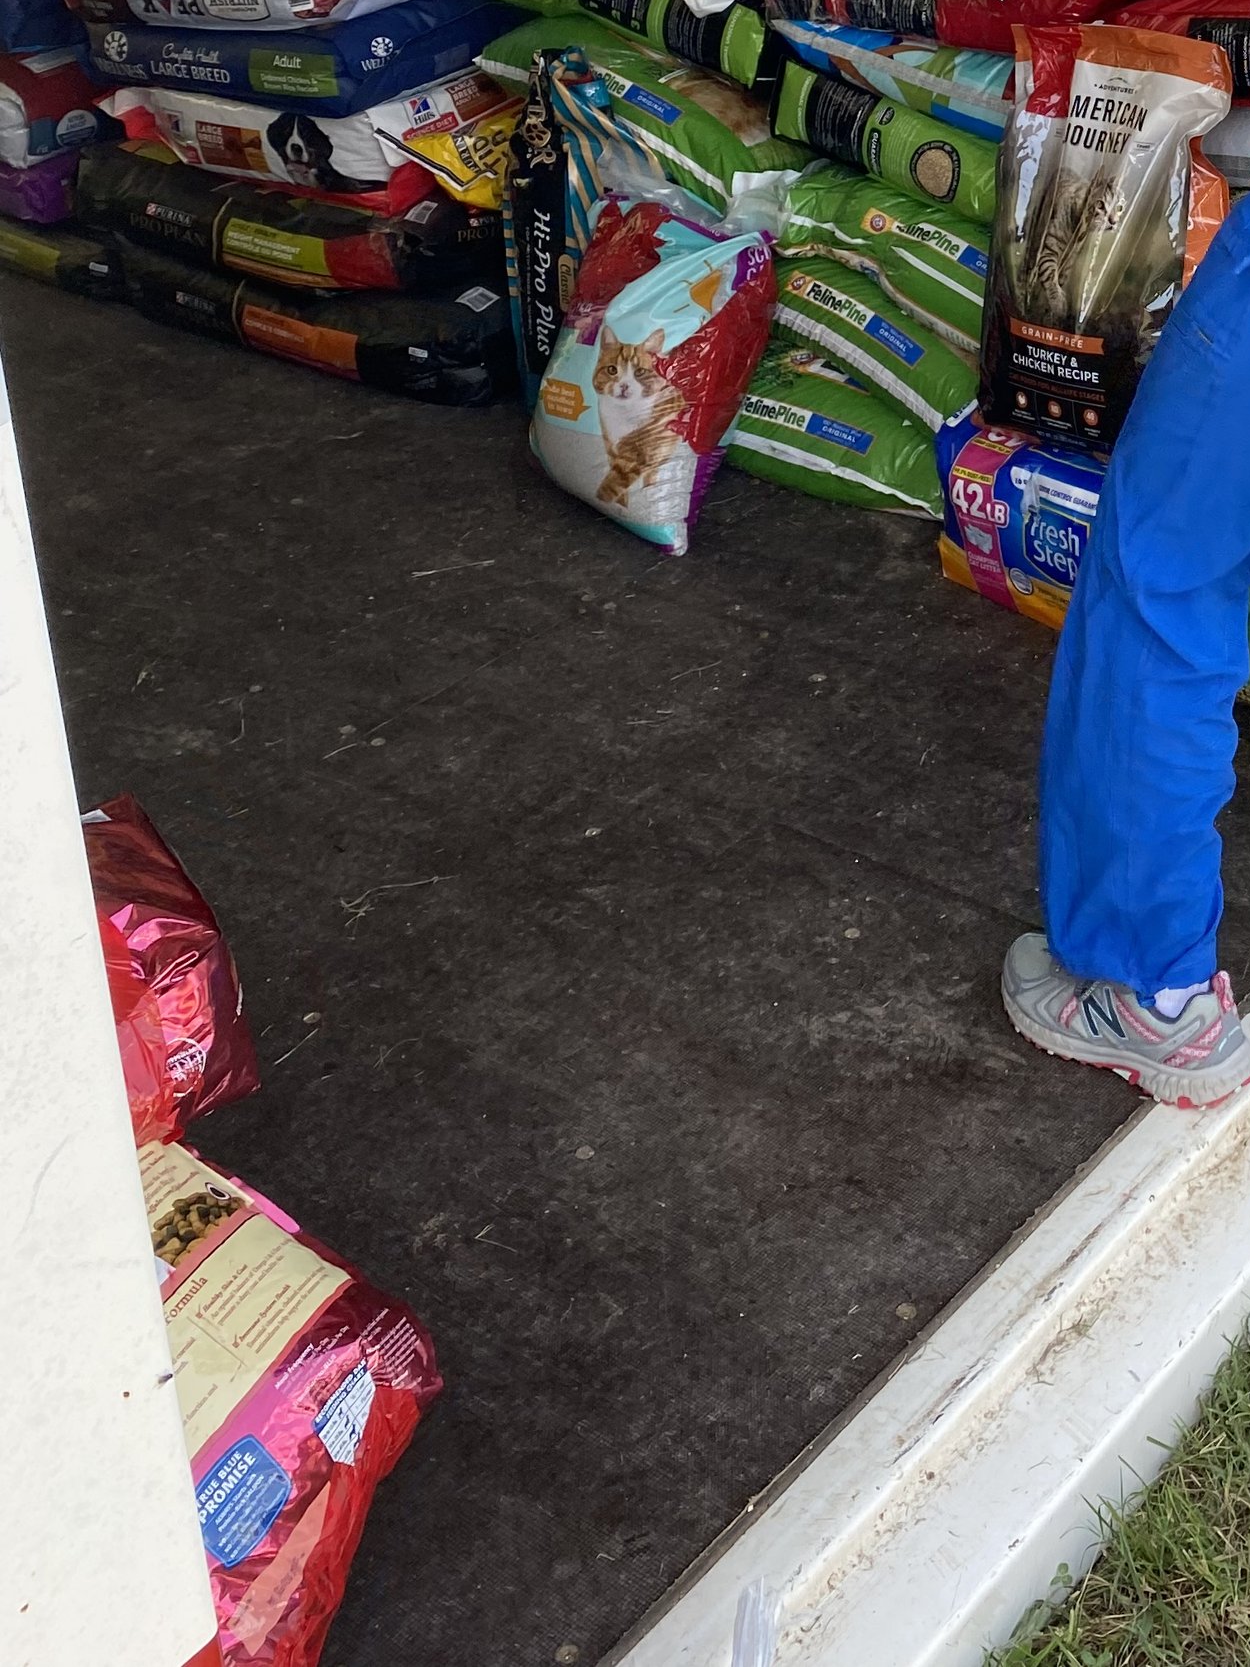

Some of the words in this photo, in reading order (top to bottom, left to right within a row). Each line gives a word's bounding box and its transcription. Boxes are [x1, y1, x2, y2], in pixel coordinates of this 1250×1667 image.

[150, 61, 188, 78] LARGE
[191, 65, 230, 84] BREED
[273, 55, 302, 69] Adult
[453, 86, 478, 102] BREED
[437, 116, 456, 129] DIET
[1070, 95, 1148, 132] MERICAN
[1064, 122, 1131, 155] JOURNEY
[156, 207, 191, 225] PURINA
[533, 208, 551, 293] Hi-Pro
[560, 263, 571, 305] Classic
[807, 281, 869, 326] FelinePine
[535, 300, 556, 355] Plus
[877, 326, 907, 352] ORIGINAL
[1021, 326, 1084, 349] GRAIN-FREE
[1012, 352, 1055, 375] CHICKEN
[1057, 366, 1100, 384] RECIPE
[1027, 344, 1067, 366] TURKEY
[1070, 356, 1078, 368] &
[821, 425, 856, 444] ORIGINAL
[952, 479, 987, 520] 42
[986, 503, 1006, 523] LB
[1050, 489, 1073, 504] CONTROL
[1034, 539, 1079, 581] Step
[203, 1289, 223, 1314] Healthy
[238, 1319, 259, 1343] Immune
[257, 1300, 277, 1322] System
[275, 1283, 291, 1305] Health
[286, 1343, 314, 1376] Frequency
[217, 1450, 242, 1478] BLUE
[199, 1452, 257, 1524] PROMISE
